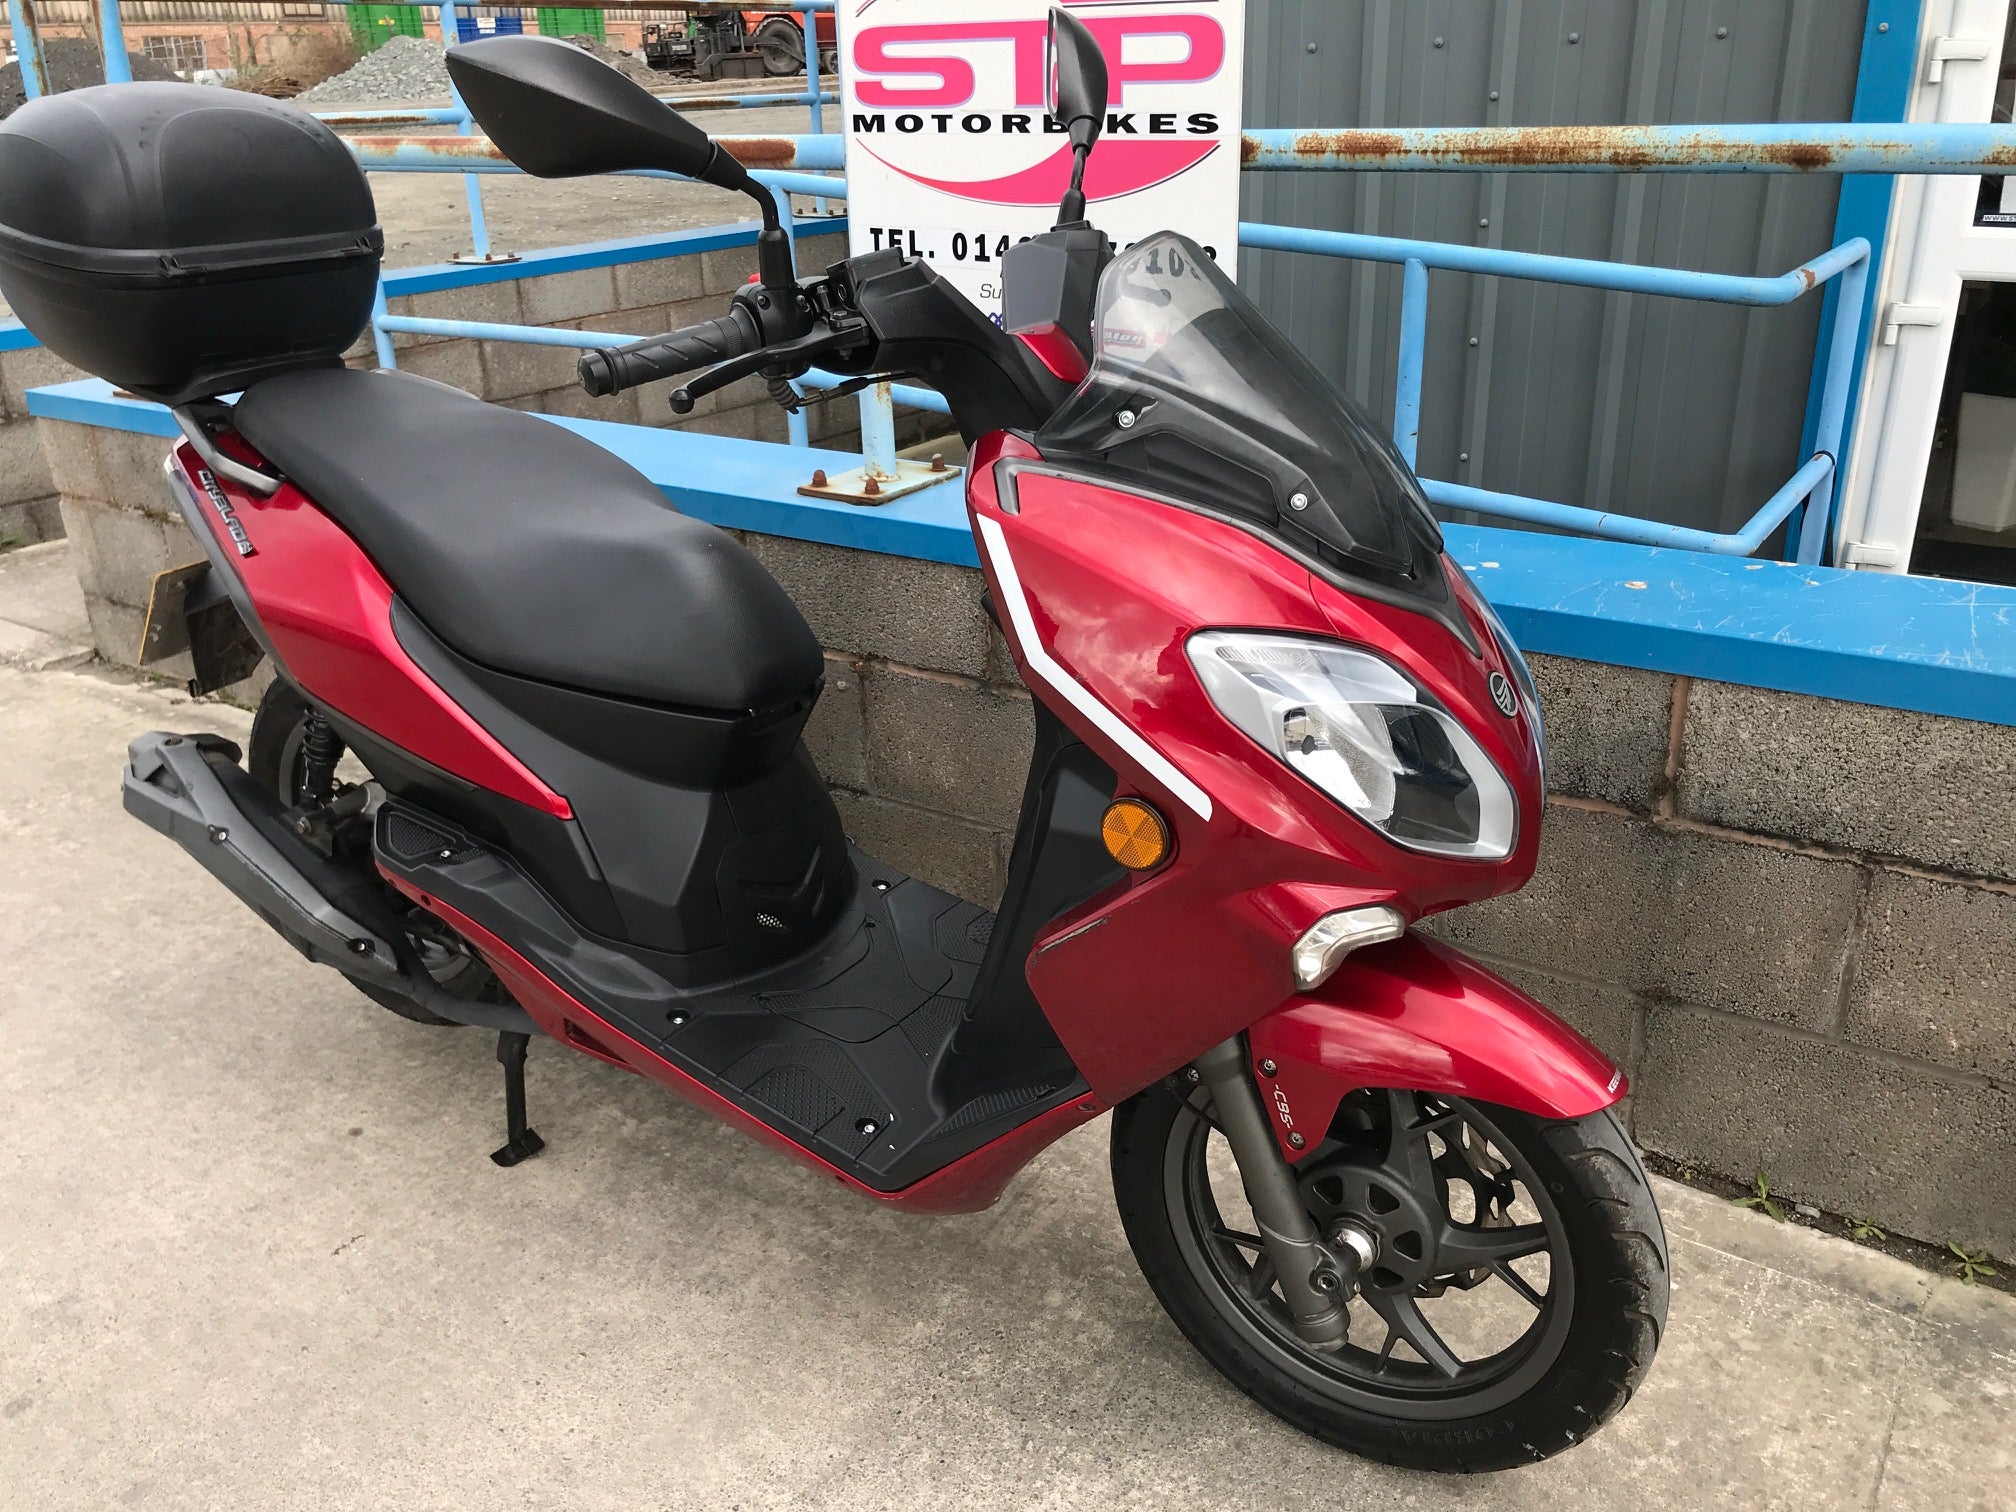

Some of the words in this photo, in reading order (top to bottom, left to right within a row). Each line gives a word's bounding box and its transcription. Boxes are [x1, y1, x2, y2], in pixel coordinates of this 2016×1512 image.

[853, 14, 1226, 109] STP
[853, 113, 1219, 134] MOTORBKES
[870, 227, 934, 258] TEL.
